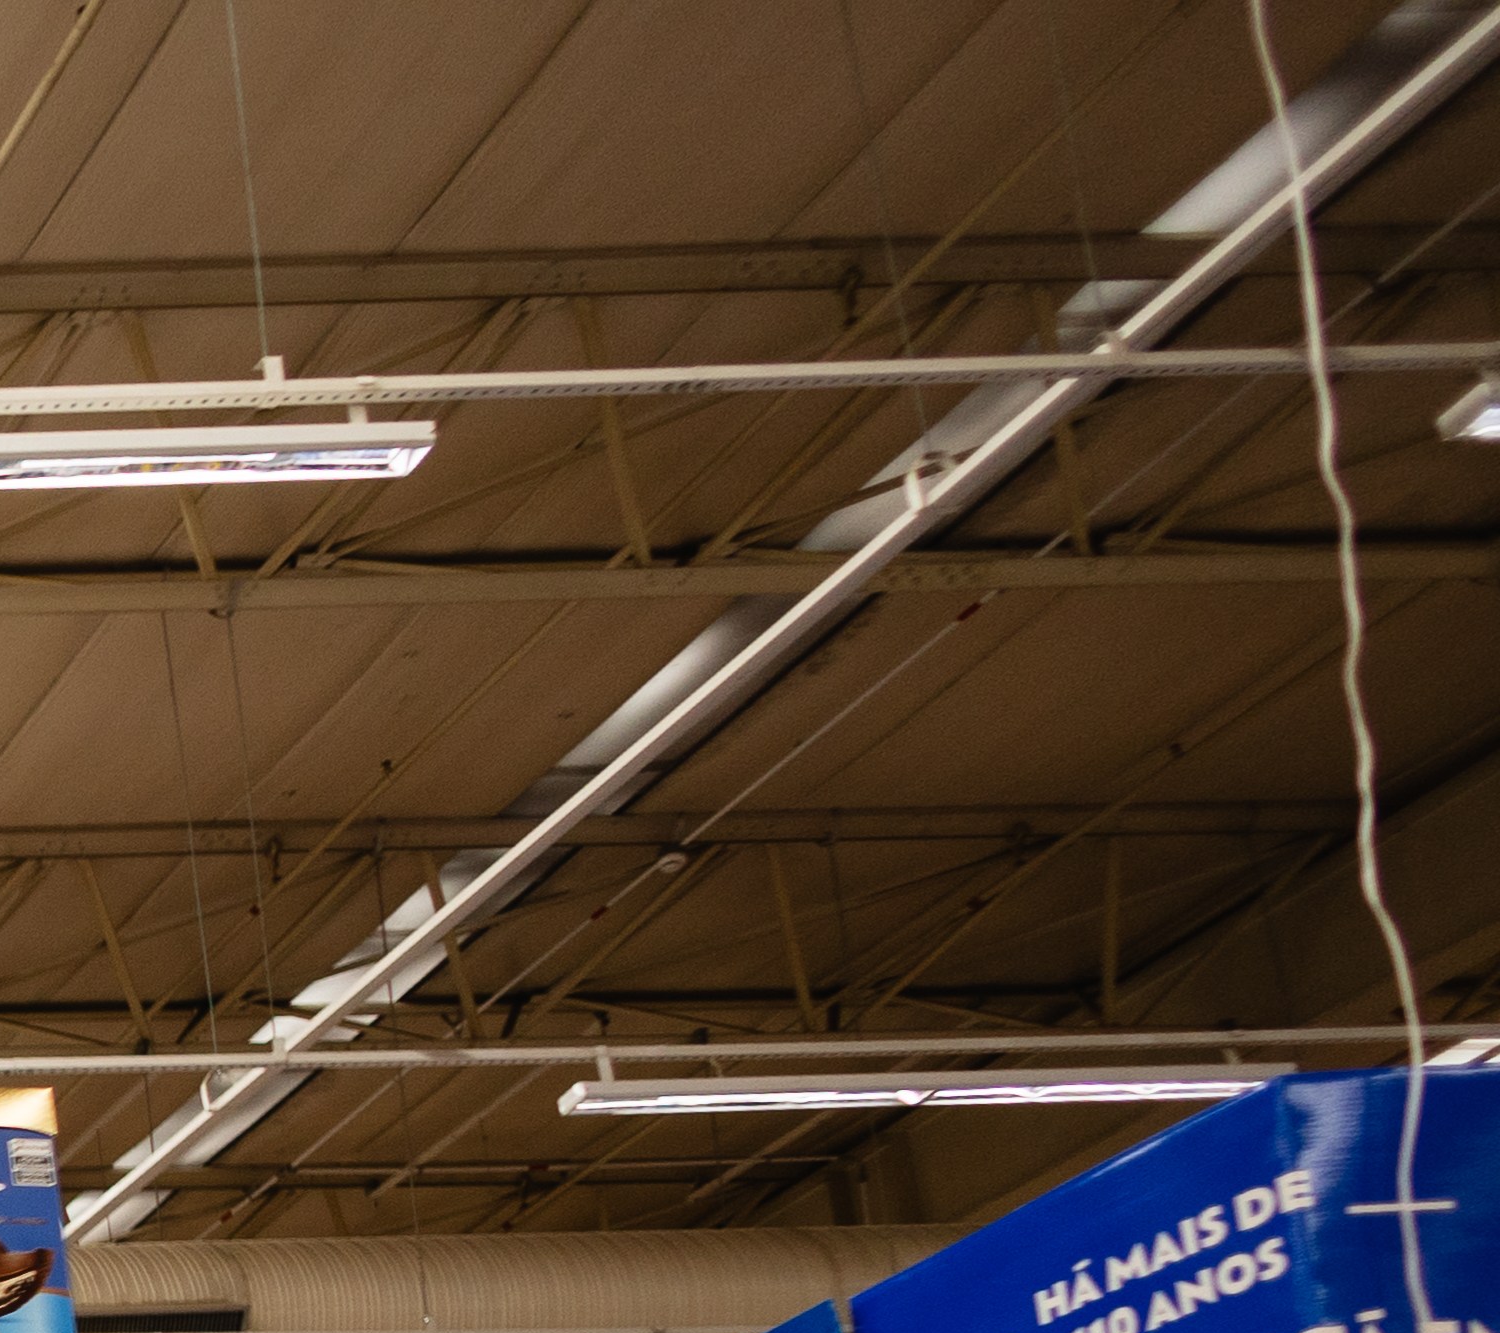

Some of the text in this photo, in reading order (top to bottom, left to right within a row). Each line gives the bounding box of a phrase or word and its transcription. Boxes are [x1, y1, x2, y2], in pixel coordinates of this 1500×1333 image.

[1033, 1170, 1317, 1326] HÁ MAIS DE
[1145, 1237, 1290, 1330] ANOS
